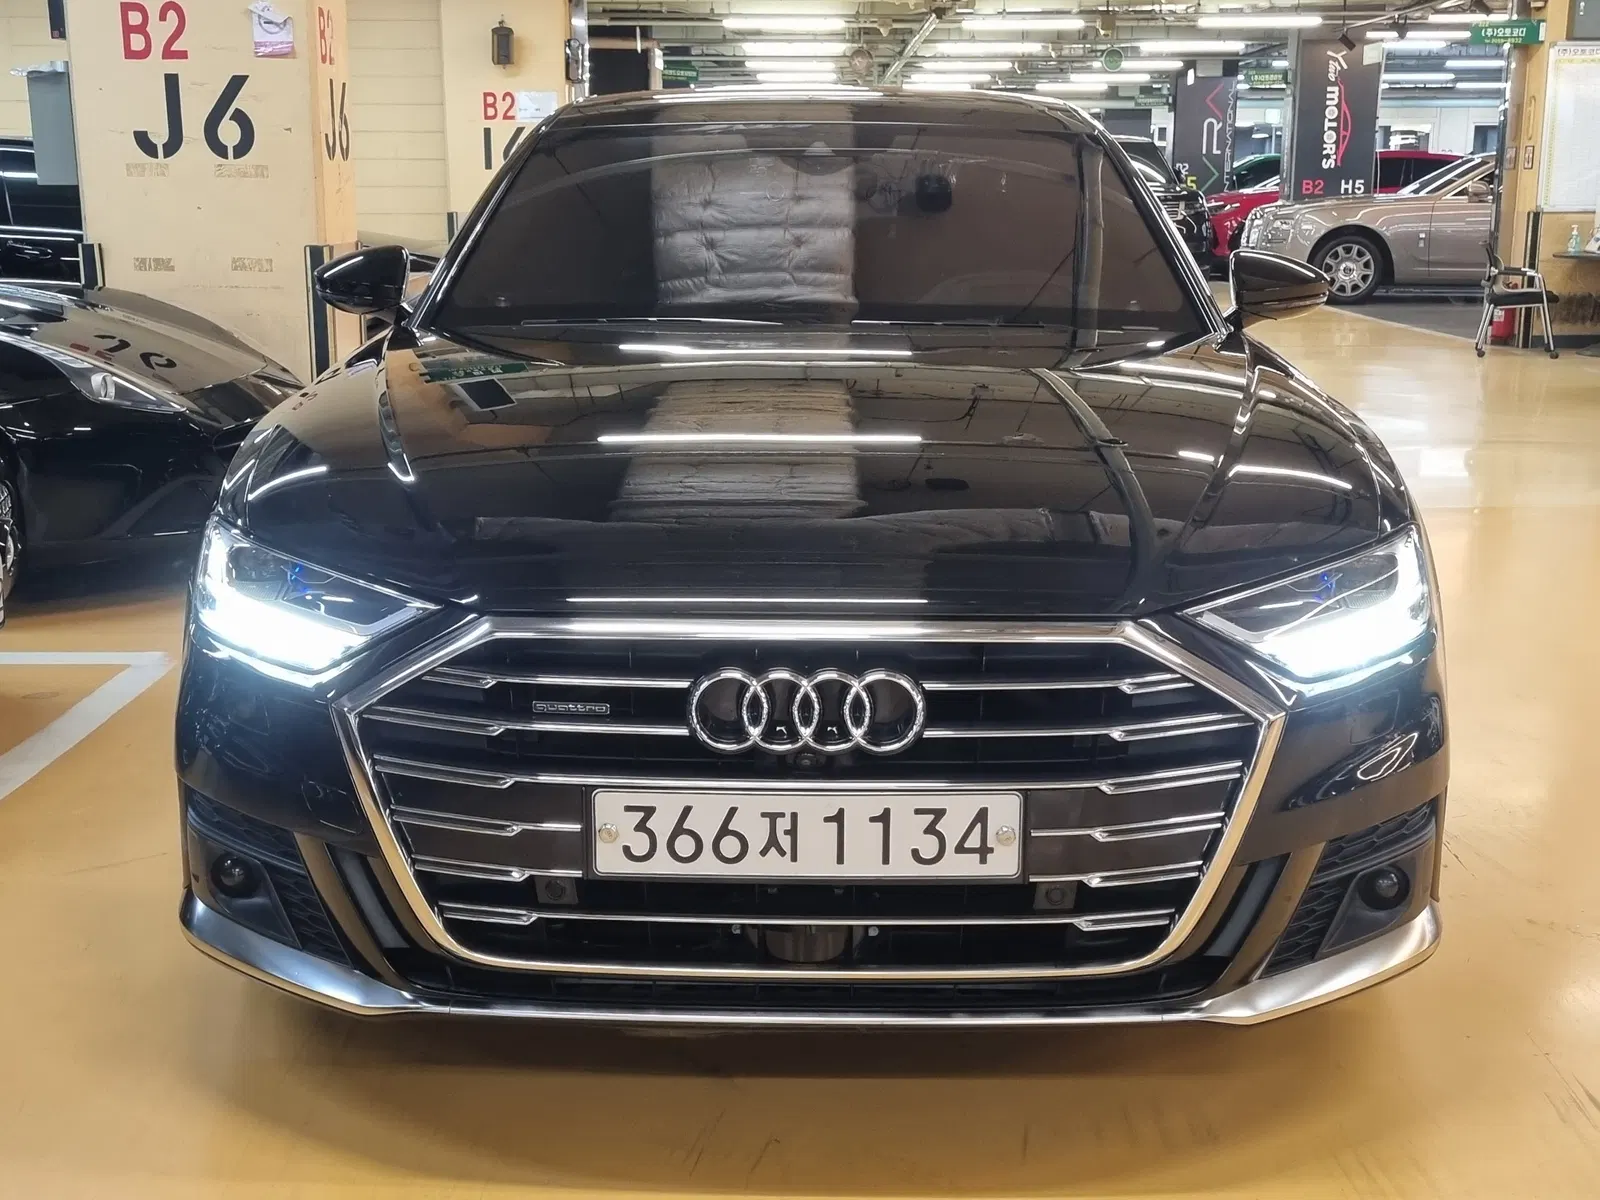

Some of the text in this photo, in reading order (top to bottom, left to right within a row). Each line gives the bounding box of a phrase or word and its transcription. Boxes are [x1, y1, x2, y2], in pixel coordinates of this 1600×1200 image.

[120, 1, 189, 60] B2
[318, 6, 335, 66] B2
[133, 73, 255, 160] J6
[324, 78, 350, 162] J6
[483, 91, 516, 120] B2
[1223, 80, 1238, 193] NTERNATIONAL
[1302, 179, 1365, 194] B2 H5
[535, 703, 607, 712] quattro
[622, 805, 994, 866] 366저 1134
